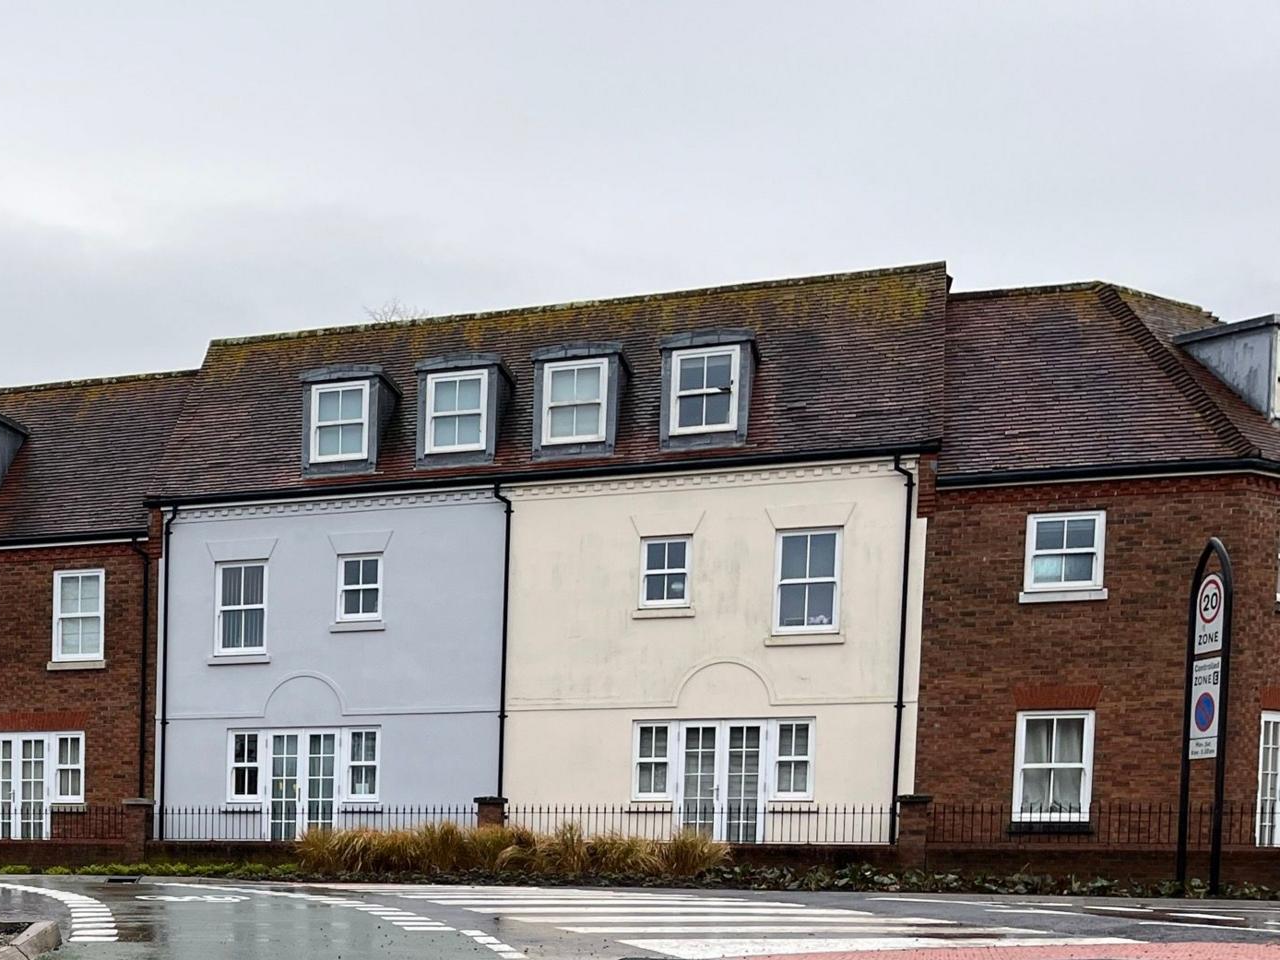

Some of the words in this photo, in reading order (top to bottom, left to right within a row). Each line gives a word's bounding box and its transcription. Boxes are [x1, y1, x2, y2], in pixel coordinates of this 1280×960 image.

[1203, 592, 1218, 612] 20
[1198, 631, 1219, 645] ZONE
[1194, 660, 1220, 673] Controlled
[1194, 673, 1212, 687] ZONE
